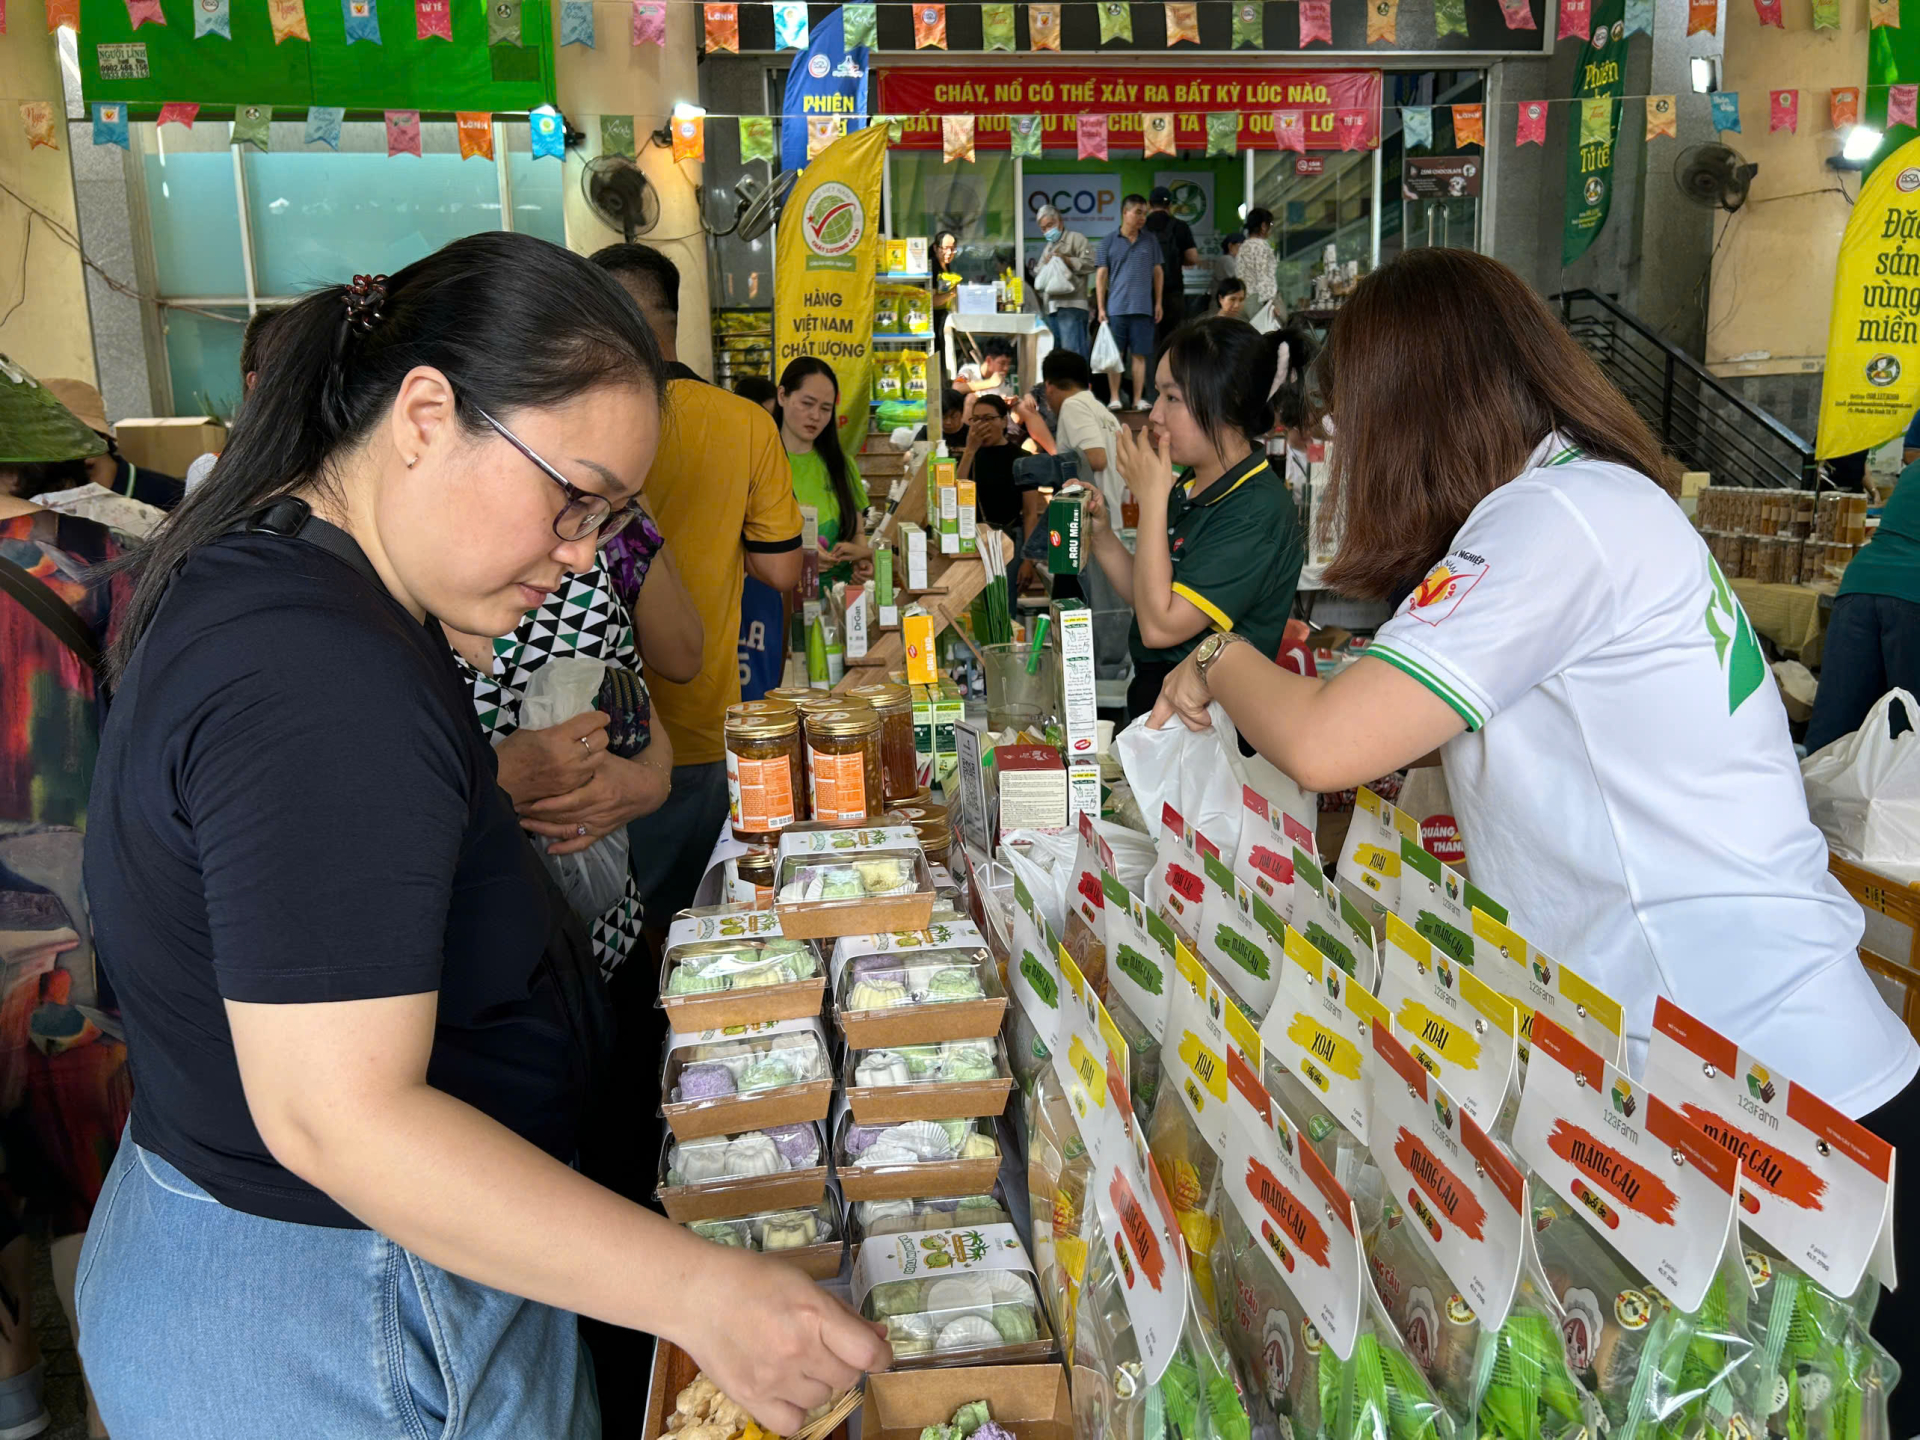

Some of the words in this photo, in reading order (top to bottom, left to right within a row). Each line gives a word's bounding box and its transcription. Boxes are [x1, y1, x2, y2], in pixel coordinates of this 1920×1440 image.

[1584, 61, 1619, 89] Phiên
[803, 92, 854, 112] PHIÊN
[935, 80, 988, 104] CHÁY,
[995, 78, 1022, 102] NỔ
[1028, 80, 1054, 102] CÓ
[1060, 78, 1094, 102] THỂ
[1101, 79, 1136, 102] XẢY
[1144, 85, 1168, 102] RA
[1175, 79, 1210, 102] BẤT
[1216, 82, 1242, 103] KỲ
[1247, 81, 1281, 102] LÚC
[1288, 82, 1331, 104] NÀO,
[904, 108, 938, 131] BẤT
[1179, 115, 1199, 131] TA
[1311, 112, 1335, 132] LƠ
[1875, 245, 1919, 276] sản
[804, 288, 843, 308] HÀNG
[1863, 279, 1920, 317] vùng
[793, 314, 819, 335] VIỆT
[820, 318, 853, 334] NAM
[1857, 311, 1917, 345] miền
[782, 332, 816, 359] CHẤT
[818, 340, 865, 361] LƯỢNG
[1067, 522, 1078, 538] MÁ
[1069, 539, 1078, 559] RAU
[1459, 550, 1485, 566] NGHIỆP
[926, 652, 934, 671] RAU
[1422, 822, 1455, 838] QUẢNG
[1433, 842, 1464, 852] THAN
[1434, 984, 1457, 1010] 123Farm
[1529, 980, 1555, 1006] 123Farm
[1421, 1018, 1449, 1050] XOÀI
[1521, 1013, 1534, 1038] XO
[1311, 1031, 1336, 1063] XOÀI
[1194, 1050, 1214, 1083] XOÀI
[1737, 1094, 1779, 1132] 123Farm
[1431, 1119, 1458, 1157] 123Farm
[1603, 1108, 1639, 1146] 123Farm
